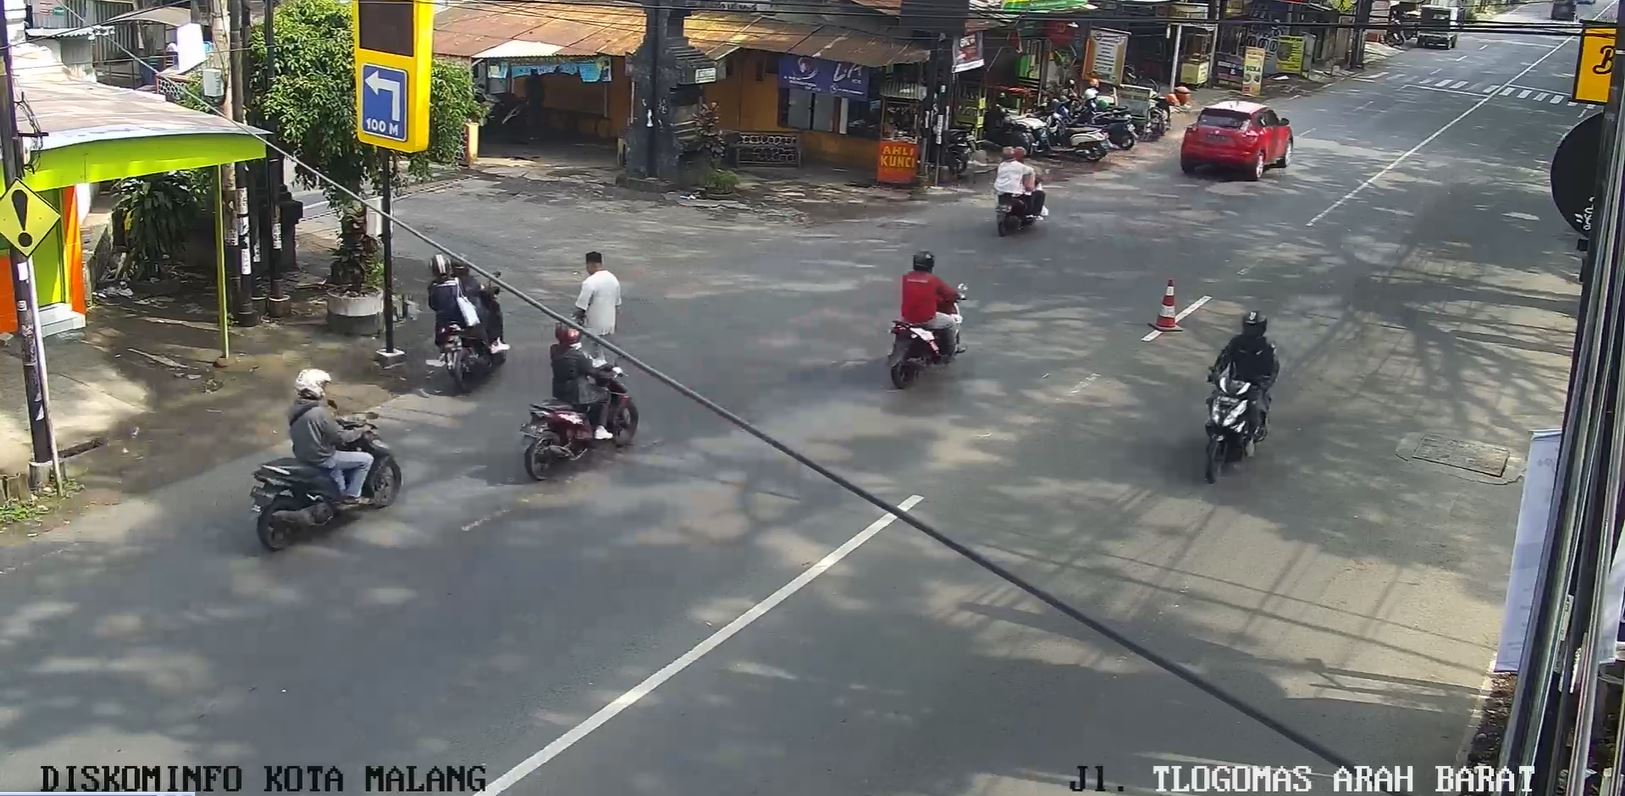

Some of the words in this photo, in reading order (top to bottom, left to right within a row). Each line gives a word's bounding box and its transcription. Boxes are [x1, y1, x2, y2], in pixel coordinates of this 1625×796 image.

[366, 117, 386, 133] 100
[389, 122, 399, 136] M
[882, 145, 914, 156] AHLI
[880, 155, 915, 168] KUNCI
